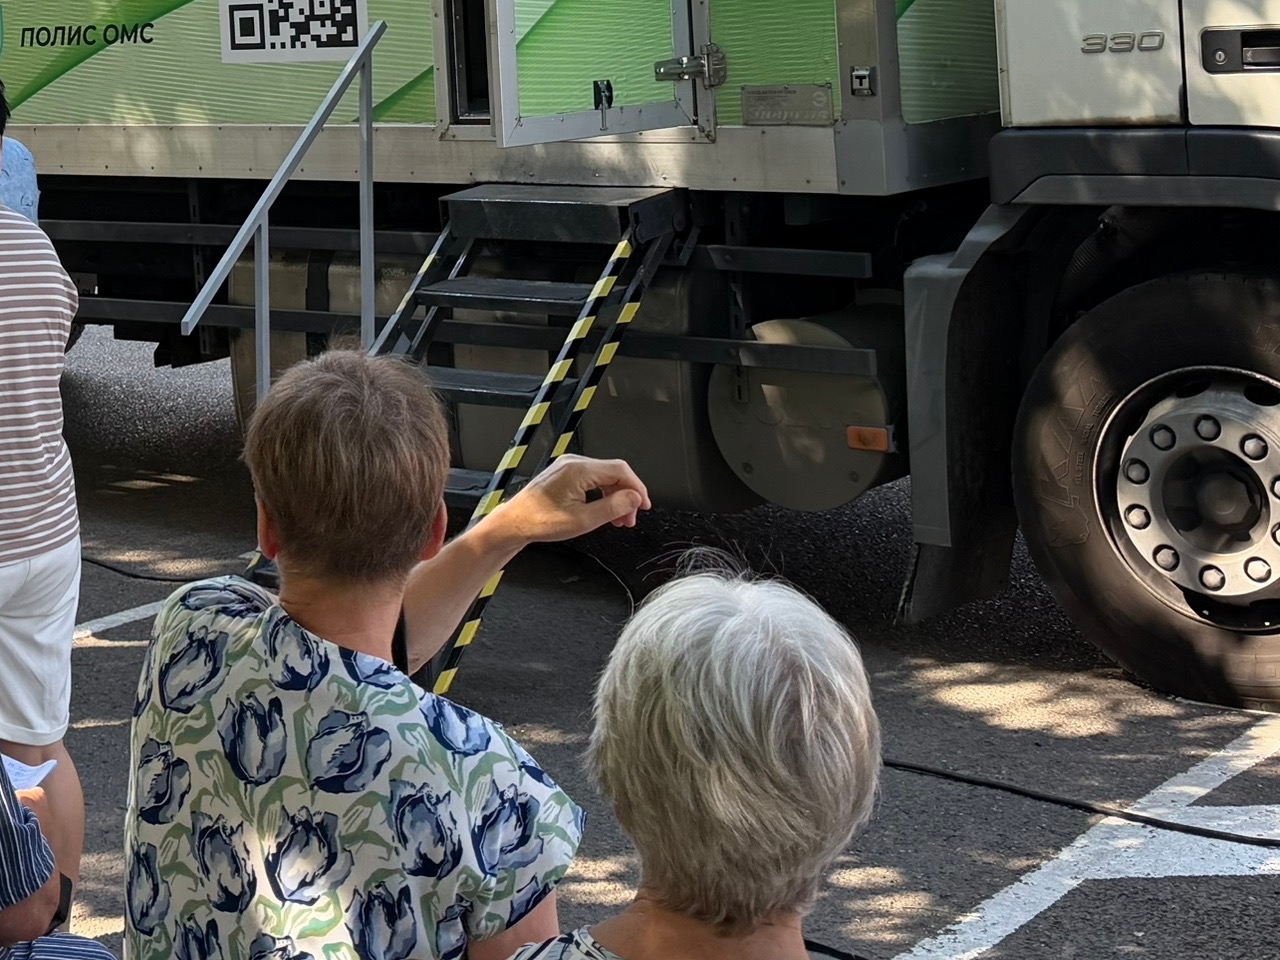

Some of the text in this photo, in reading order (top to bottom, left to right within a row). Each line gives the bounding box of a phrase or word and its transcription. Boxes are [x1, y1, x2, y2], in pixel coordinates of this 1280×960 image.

[20, 22, 155, 48] ПОЛИС ОМС
[1081, 29, 1165, 54] 330
